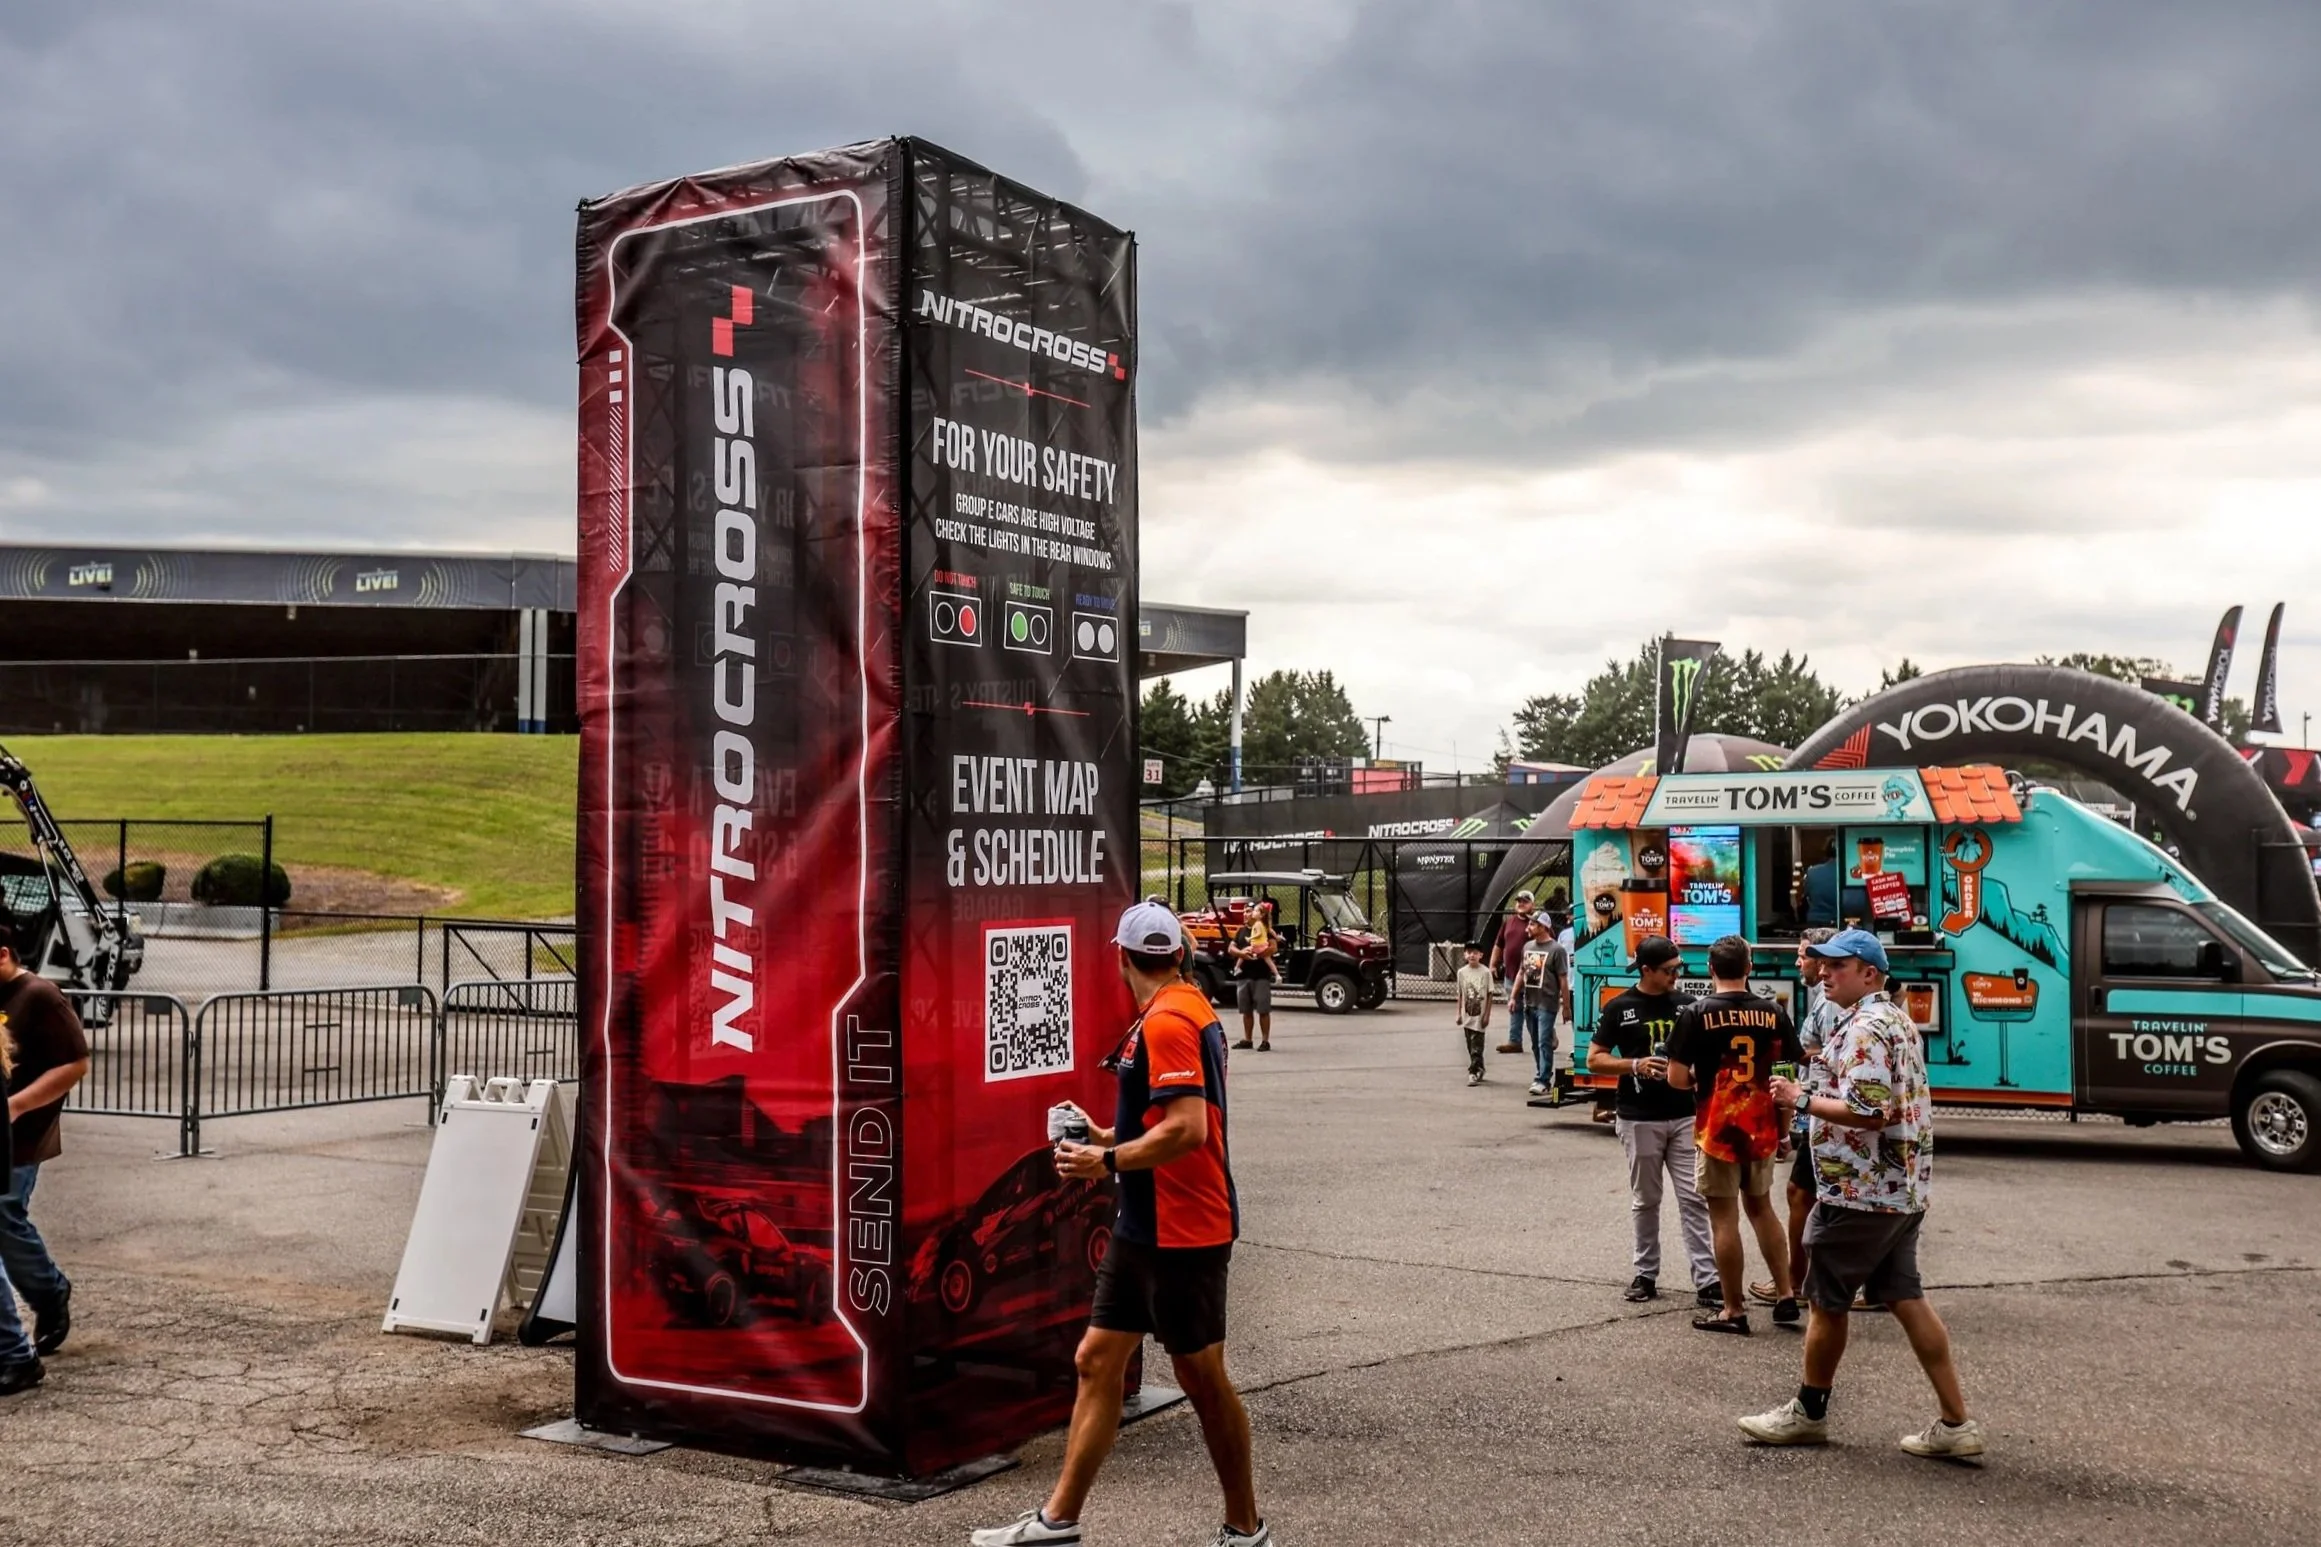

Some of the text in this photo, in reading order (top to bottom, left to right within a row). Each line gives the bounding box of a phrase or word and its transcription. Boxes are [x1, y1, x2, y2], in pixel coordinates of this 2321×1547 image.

[920, 289, 1108, 374] NITROCROSS
[933, 416, 1117, 505] FOR YOUR SAFETY
[955, 493, 1096, 541] GROUP E CARS ARE HIGH VOLTAGE
[935, 518, 1112, 570] CHECK THE LIGHTS IN THE REAR WINDOWS
[934, 569, 977, 588] DO NOT TOUCH
[1009, 582, 1050, 600] SAFE TO TOUCH
[2207, 648, 2233, 724] YOKOHAMA
[710, 366, 757, 1053] NITROCROSS
[1877, 696, 2199, 811] YOKOHAMA
[953, 755, 1037, 814] EVENT
[1045, 760, 1099, 815] MAP
[1145, 770, 1161, 782] 31
[1665, 785, 1876, 811] TRAVELIN' TOM'S COFFEE
[1368, 818, 1455, 838] NITROCROSS
[947, 828, 1106, 887] & SCHEDULE
[1417, 855, 1455, 865] MONSTER
[1641, 856, 1664, 864] TOM'S
[1681, 889, 1732, 904] TOM'S
[1872, 881, 1900, 892] ACCEPTED
[1963, 875, 1974, 918] ORDER
[1629, 917, 1664, 928] TOM'S
[1703, 1010, 1776, 1030] ILLENIUM
[2132, 1020, 2207, 1033] TRAVELIN'
[1730, 1035, 1756, 1083] 3
[2108, 1033, 2232, 1064] TOM'S
[2143, 1063, 2197, 1076] COFFEE
[848, 1014, 893, 1316] SEND IT
